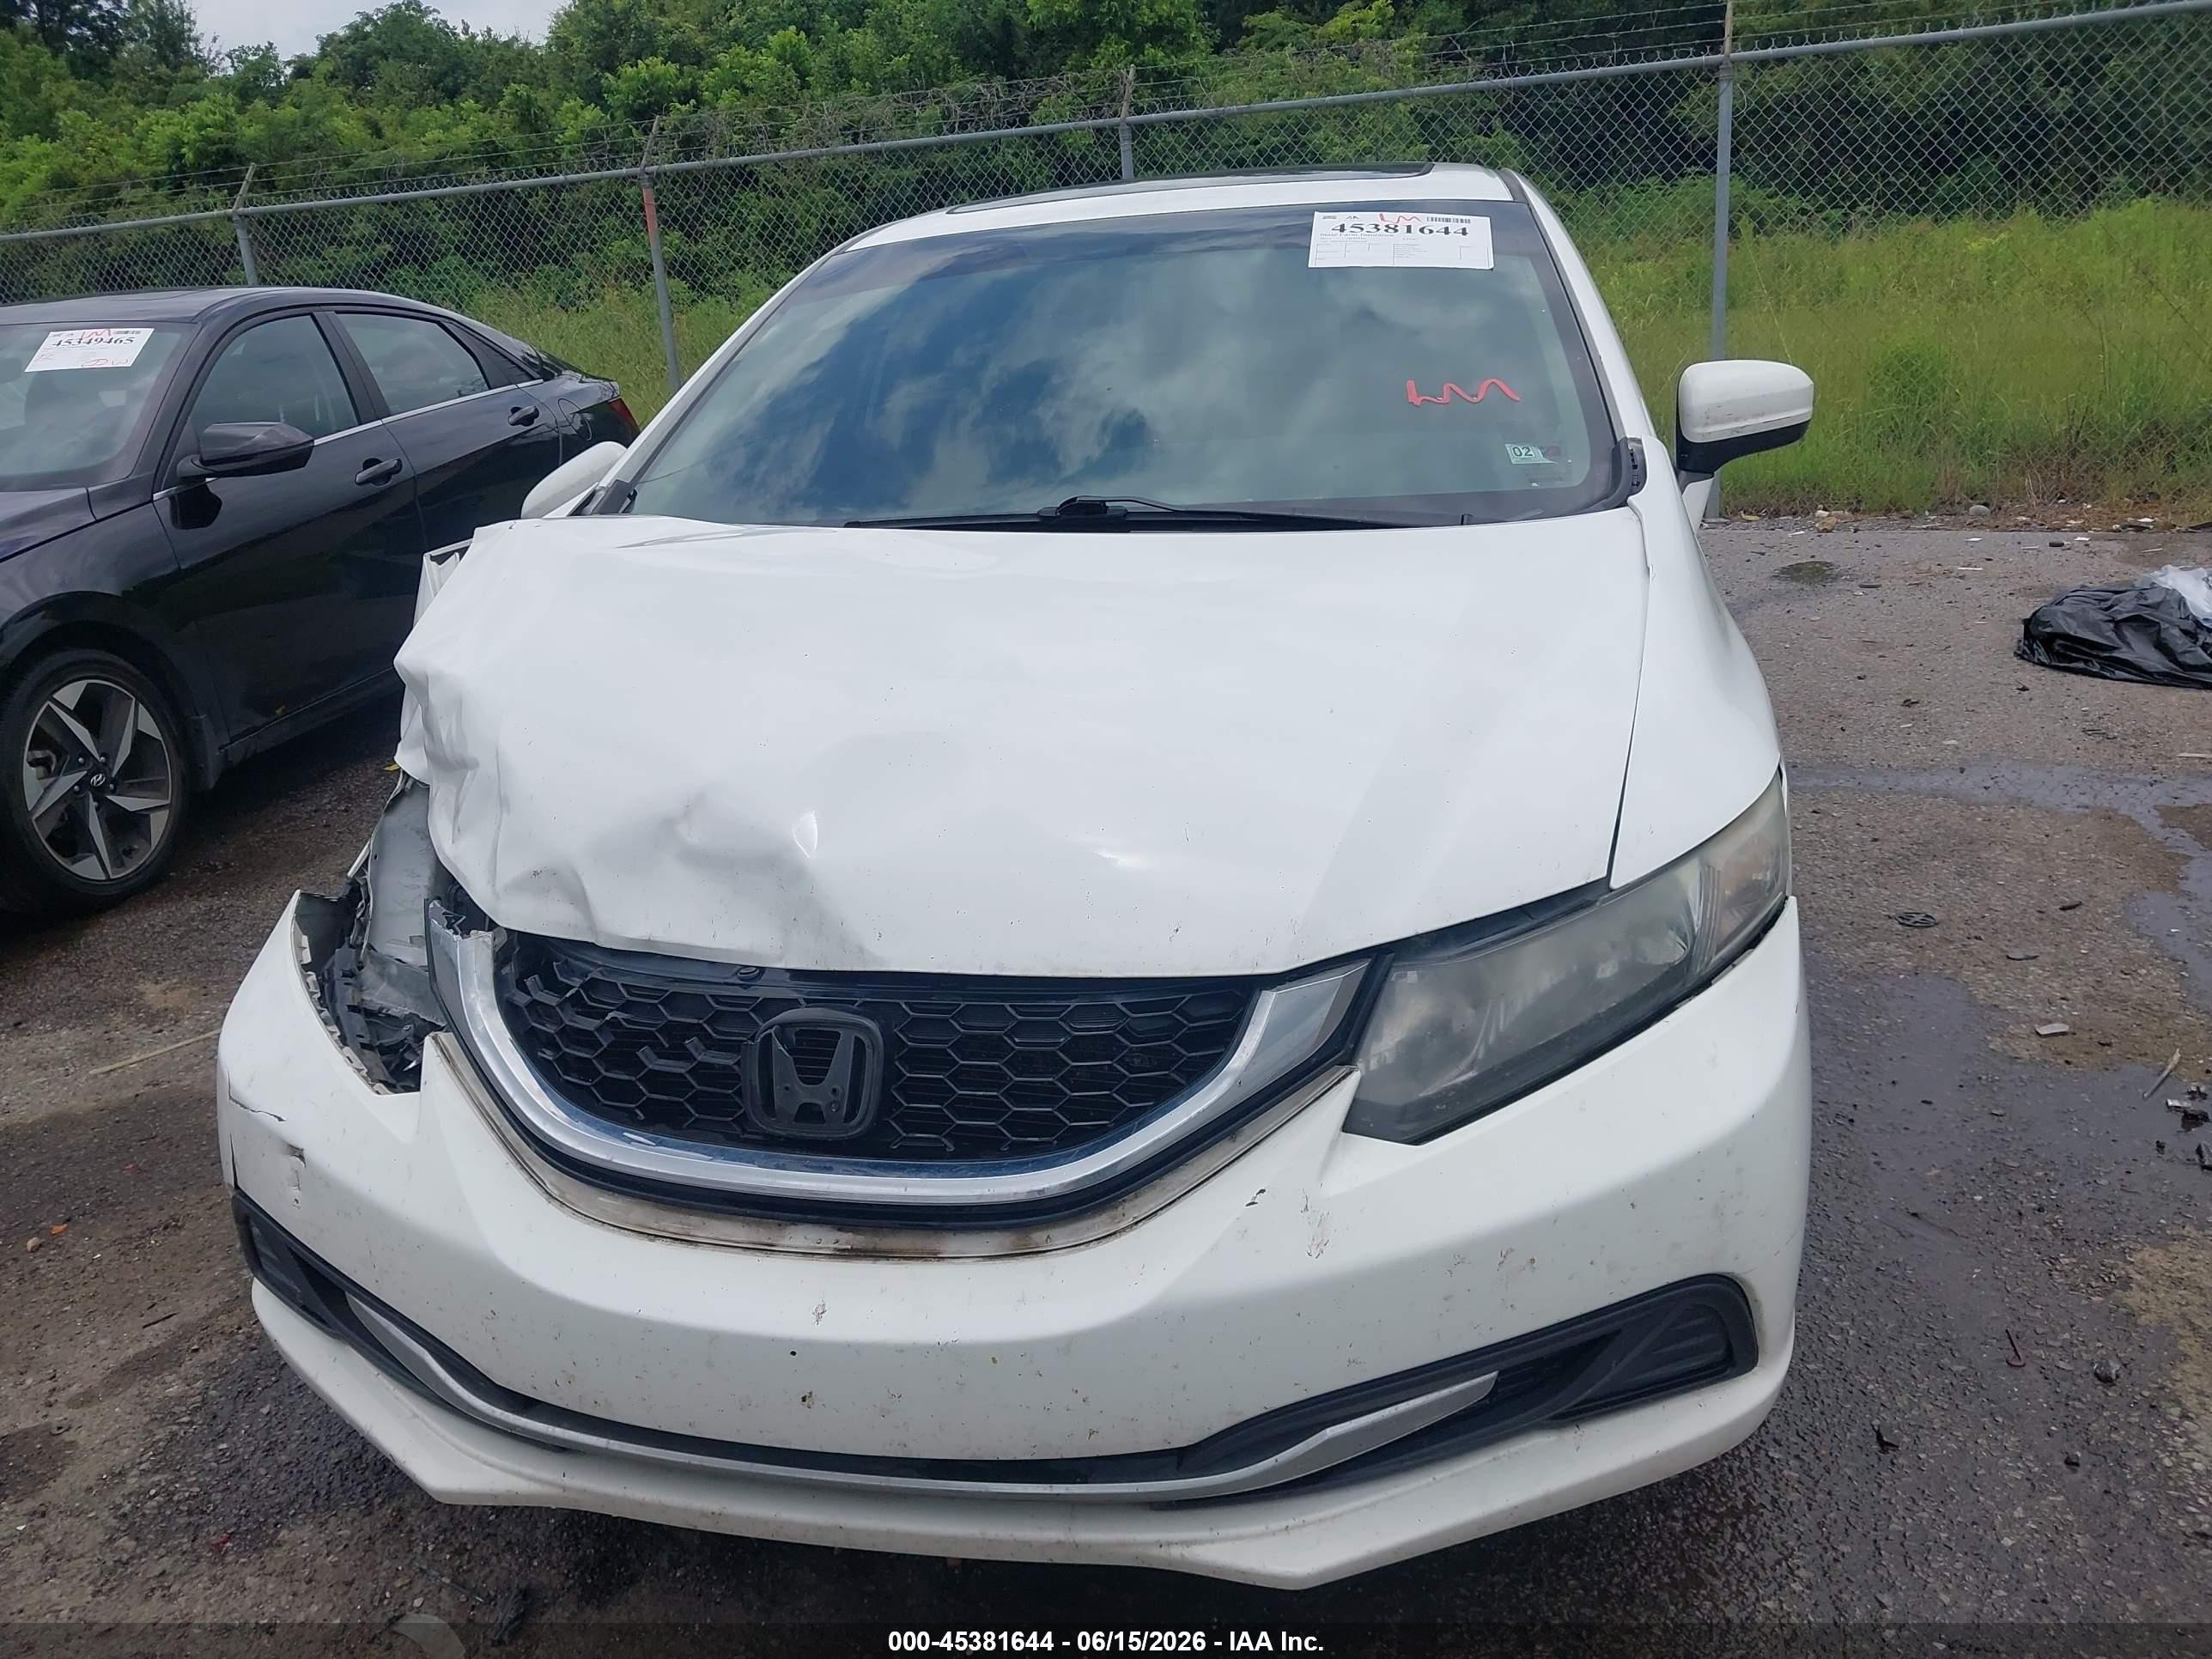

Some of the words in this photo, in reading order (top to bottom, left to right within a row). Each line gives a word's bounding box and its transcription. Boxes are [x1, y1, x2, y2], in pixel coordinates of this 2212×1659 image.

[1331, 222, 1469, 236] 45381644
[52, 337, 135, 347] 45349465
[1512, 446, 1533, 457] 02
